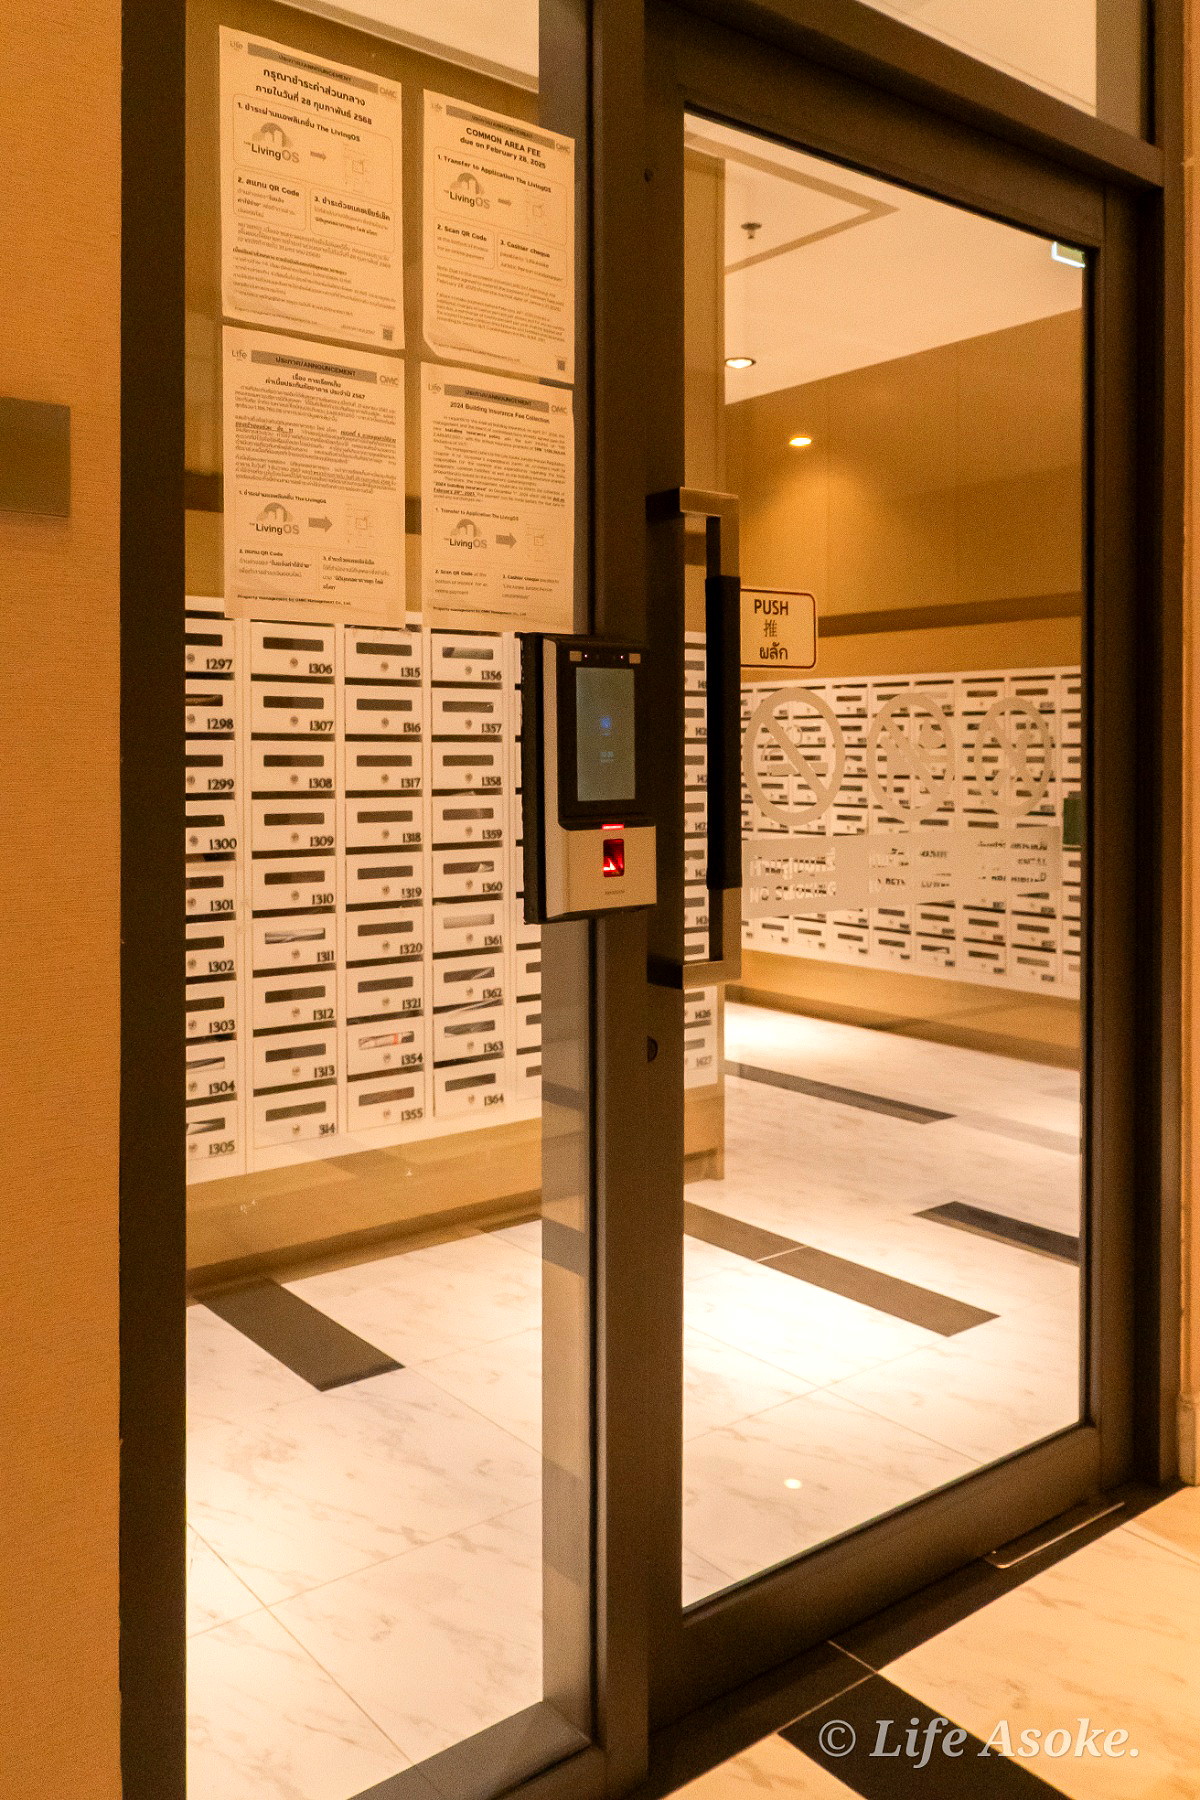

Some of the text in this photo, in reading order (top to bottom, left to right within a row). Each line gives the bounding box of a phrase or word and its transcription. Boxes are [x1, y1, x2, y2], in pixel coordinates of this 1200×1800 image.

[301, 98, 311, 106] 28
[354, 112, 372, 125] 2568
[466, 128, 541, 157] COMMON AREA FEE
[251, 144, 300, 163] LivingOS
[460, 137, 473, 146] due
[486, 144, 518, 160] February
[531, 159, 546, 169] 2025
[444, 156, 471, 168] Transfer
[481, 166, 514, 182] Application
[282, 187, 300, 197] Code
[449, 191, 490, 209] LivingOS
[444, 226, 460, 236] Scan
[472, 232, 487, 242] Code
[450, 401, 464, 409] 2024
[465, 404, 487, 414] Building
[488, 407, 514, 418] Insurance
[256, 523, 300, 536] LivingOS
[450, 539, 487, 550] LivingOS
[754, 598, 789, 615] PUSH
[763, 619, 778, 637] 推
[759, 642, 788, 660] ผลัก
[206, 658, 233, 670] 1297
[308, 662, 333, 674] 1306
[400, 666, 421, 678] 1315
[481, 670, 502, 680] 1356
[206, 718, 234, 730] 1298
[309, 720, 334, 732] 1307
[403, 722, 422, 733] 1316
[481, 723, 502, 734] 1357
[207, 778, 234, 790] 1299
[308, 778, 333, 789] 1308
[401, 778, 421, 788] 1317
[482, 776, 502, 787] 1358
[402, 832, 422, 844] 1318
[482, 829, 502, 840] 1359
[209, 838, 237, 850] 1300
[309, 836, 334, 848] 1309
[401, 888, 422, 898] 1319
[482, 882, 503, 893] 1360
[311, 893, 334, 905] 1310
[210, 900, 234, 912] 1301
[484, 934, 502, 946] 1361
[400, 942, 423, 955] 1320
[316, 950, 335, 962] 1311
[208, 960, 235, 973] 1302
[482, 987, 502, 999] 1362
[402, 998, 422, 1010] 1321
[312, 1008, 335, 1020] 1312
[208, 1020, 236, 1033] 1303
[484, 1040, 504, 1053] 1363
[401, 1053, 424, 1066] 1354
[314, 1064, 336, 1078] 1313
[208, 1080, 236, 1094] 1304
[484, 1094, 504, 1106] 1364
[401, 1108, 424, 1122] 1355
[208, 1140, 236, 1156] 1305
